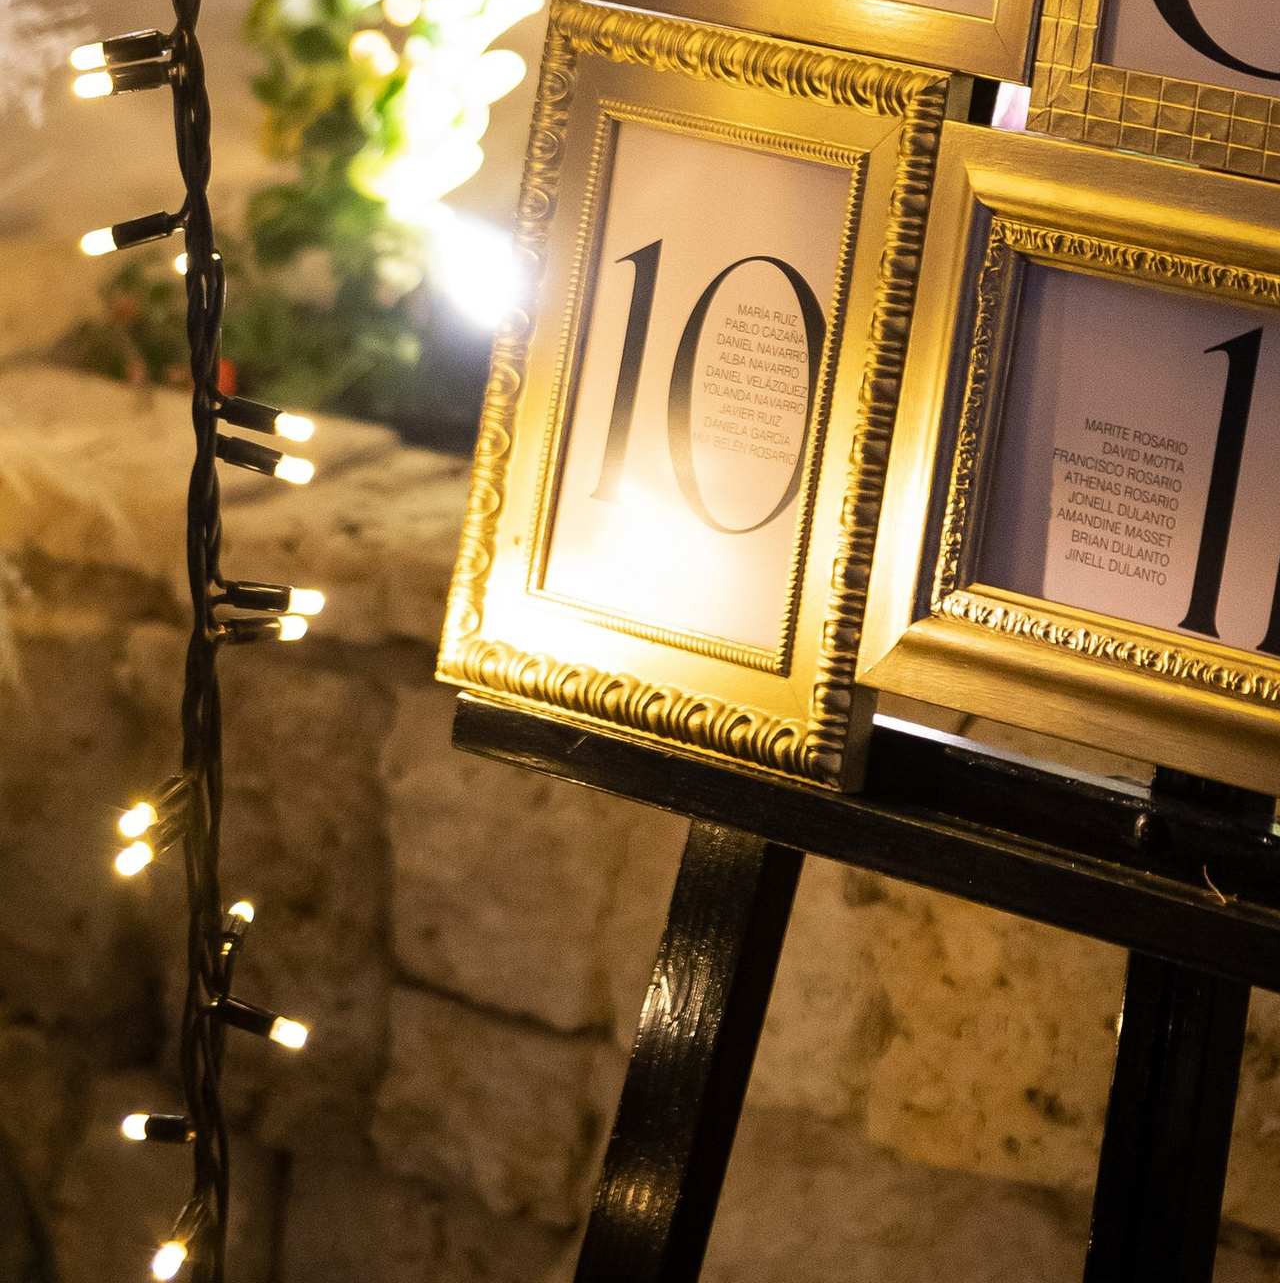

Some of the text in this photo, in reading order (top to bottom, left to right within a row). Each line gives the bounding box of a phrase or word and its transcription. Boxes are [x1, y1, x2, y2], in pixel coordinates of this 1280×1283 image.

[725, 317, 759, 335] PABLO
[773, 310, 798, 327] RUIZ
[717, 333, 807, 364] DANIEL NAVARRO
[706, 365, 742, 384] DANIEL
[719, 352, 800, 379] ALBA NAVARRO
[590, 239, 827, 535] 10
[703, 382, 806, 415] YOLANDA NAVARRO
[704, 416, 747, 436] DANIELA
[719, 403, 782, 427] JAVIER RUIZ
[1085, 417, 1188, 455] MARITE ROSARIO
[1053, 448, 1182, 493] FRANCISCO ROSARIO
[1102, 441, 1184, 473] DAVID MOTTA
[1064, 471, 1179, 511] ATHENAS ROSARIO
[1068, 491, 1176, 530] JONELL DULANTO
[1057, 507, 1173, 548] AMANDINE MASSET
[1071, 529, 1170, 567] BRIAN DULANTO
[1065, 548, 1166, 586] JINELL DULANTO
